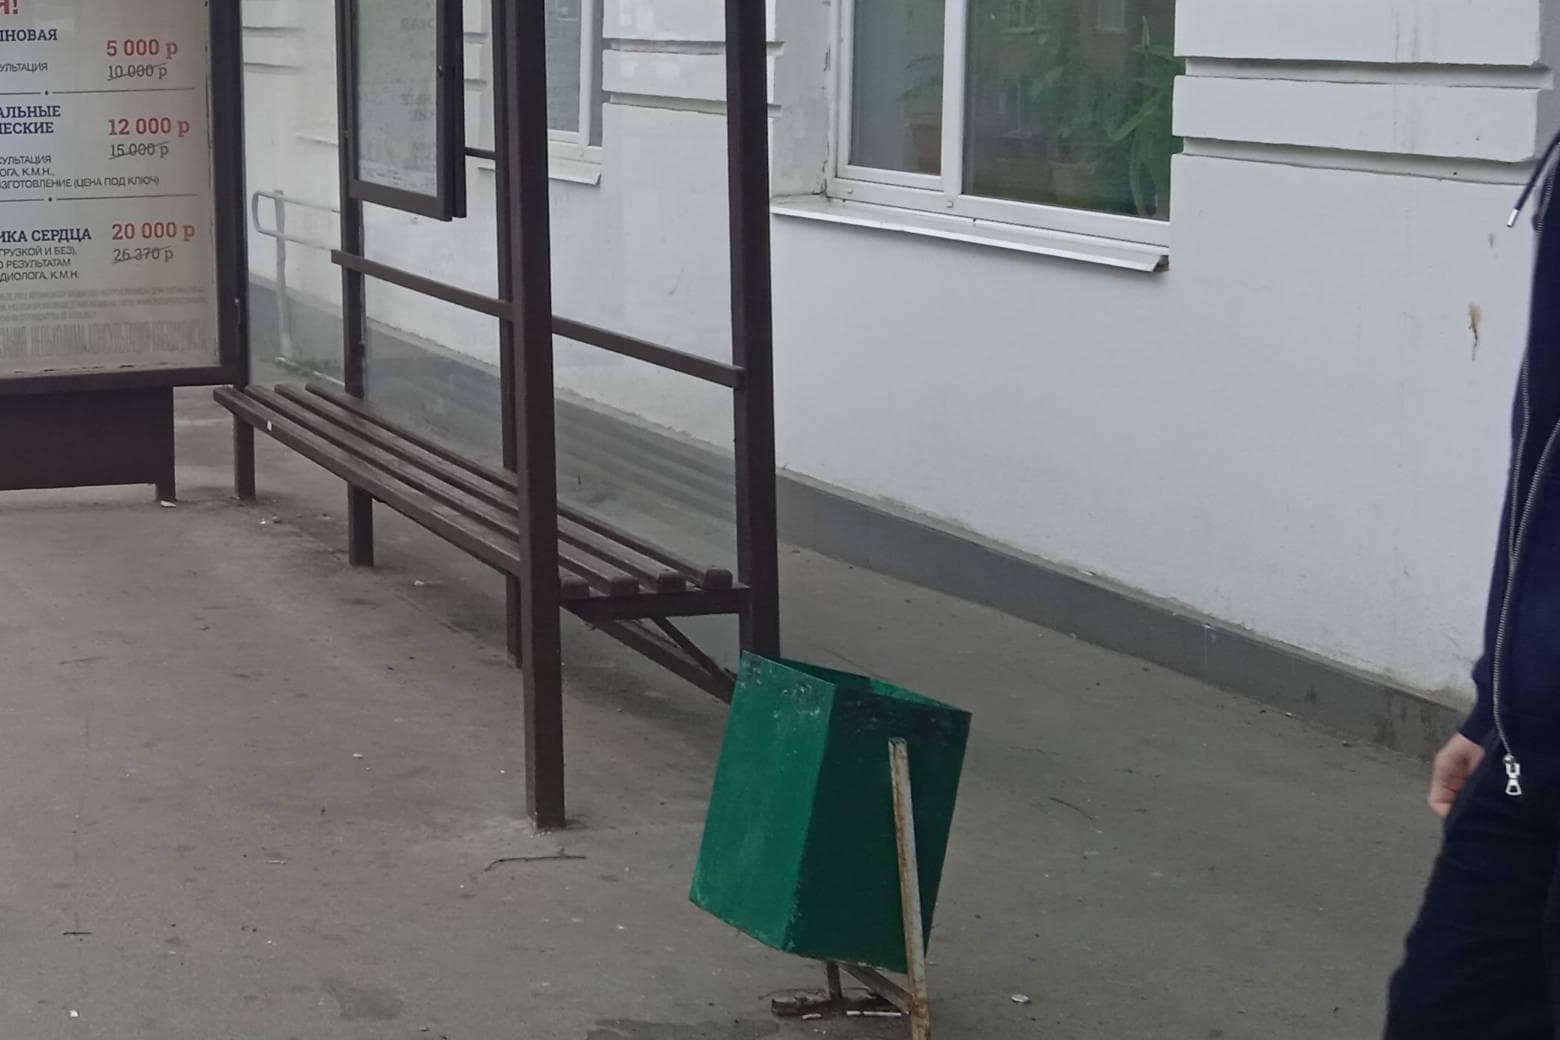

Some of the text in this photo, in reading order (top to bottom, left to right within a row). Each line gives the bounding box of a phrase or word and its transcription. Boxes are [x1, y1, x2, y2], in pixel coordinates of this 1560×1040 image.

[106, 40, 118, 57] 5
[123, 39, 160, 56] 000
[108, 118, 130, 136] 12
[135, 117, 172, 135] 000
[104, 177, 126, 187] ПОД
[31, 228, 92, 245] СЕРДЦА
[112, 223, 135, 240] 20
[142, 222, 177, 239] 000
[44, 246, 52, 256] И
[6, 259, 71, 269] РЕЗУЛЬТАТАМ
